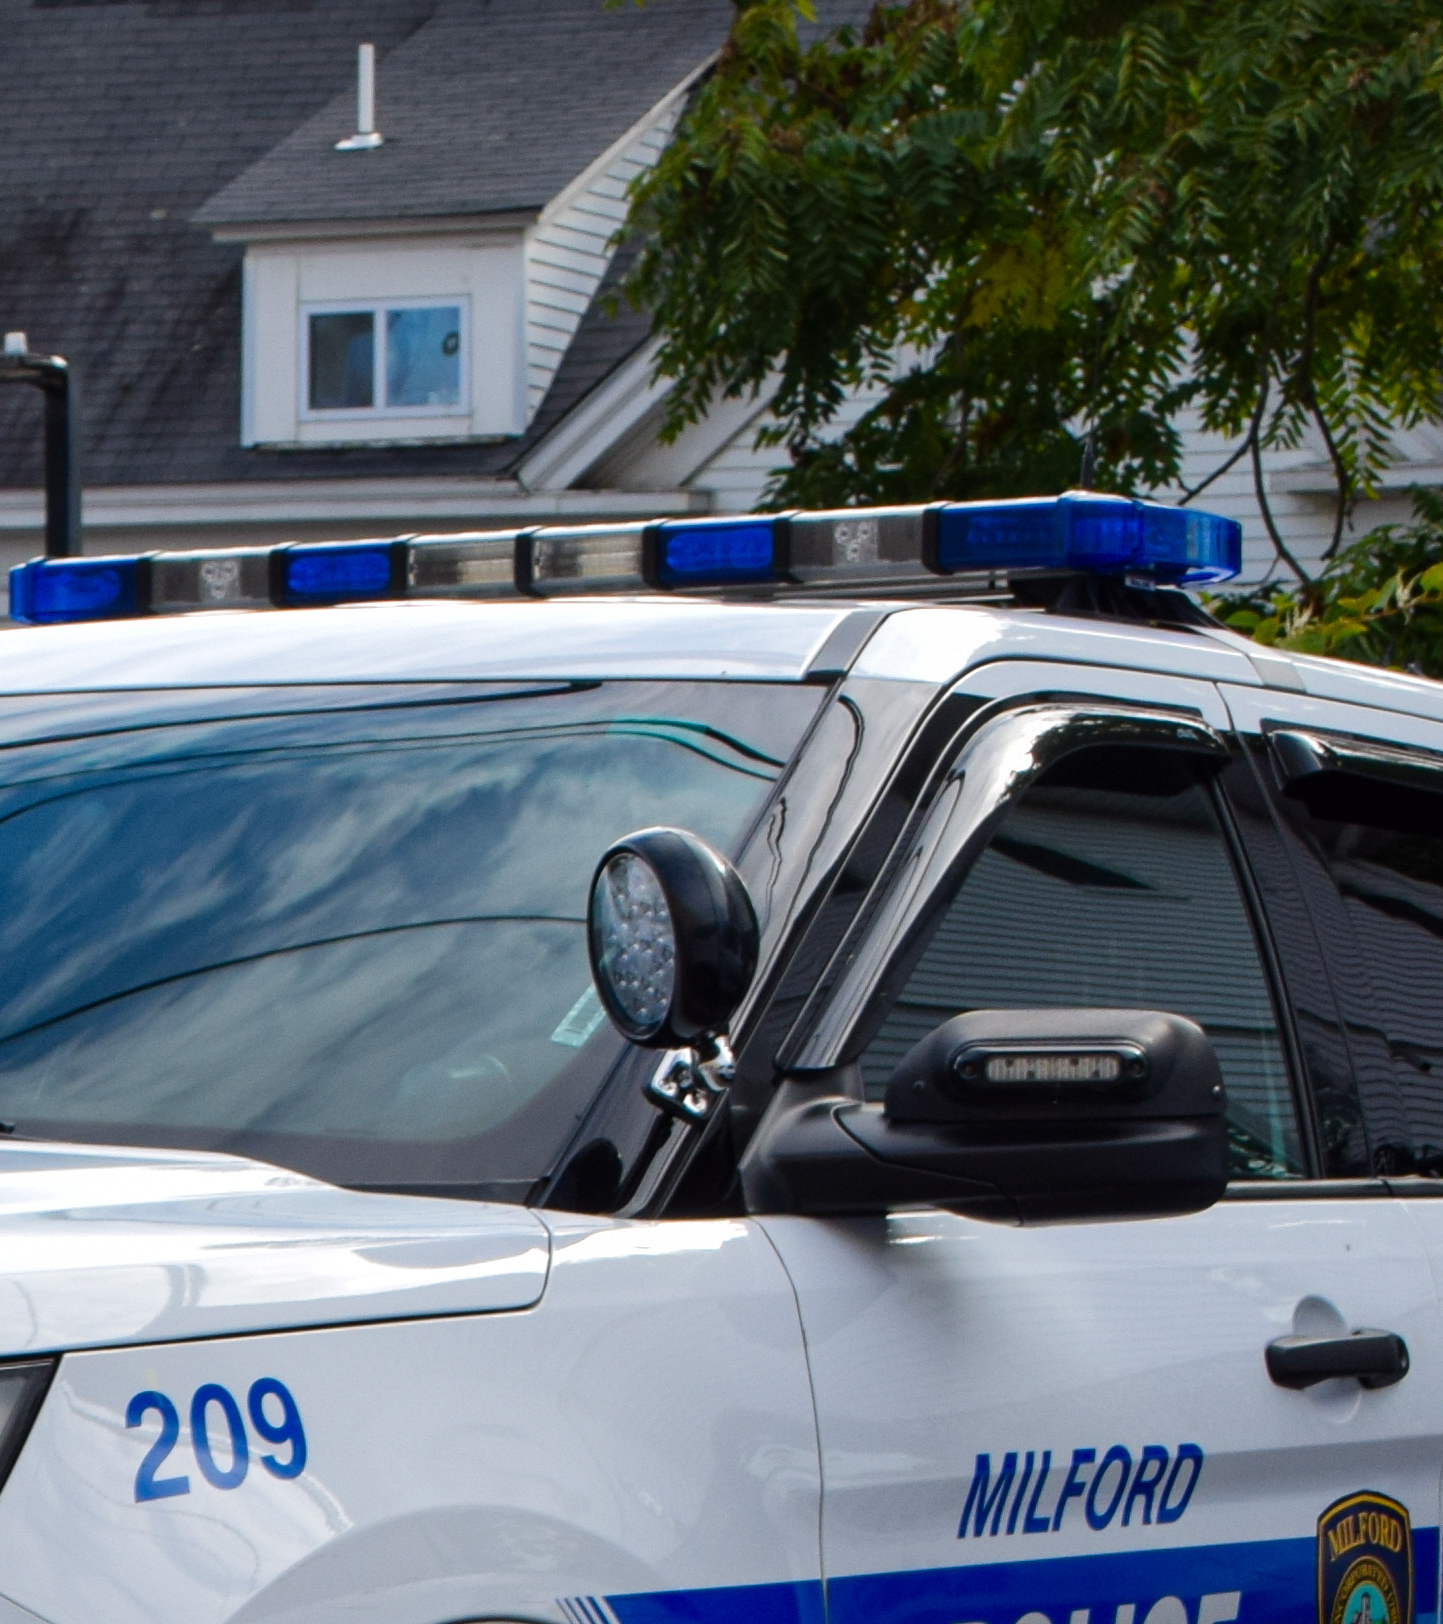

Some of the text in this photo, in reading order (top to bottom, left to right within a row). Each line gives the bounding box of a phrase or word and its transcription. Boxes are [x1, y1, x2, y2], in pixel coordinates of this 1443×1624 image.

[125, 1377, 308, 1503] 209
[957, 1442, 1205, 1540] MILFORD
[1327, 1511, 1403, 1562] MILFORD
